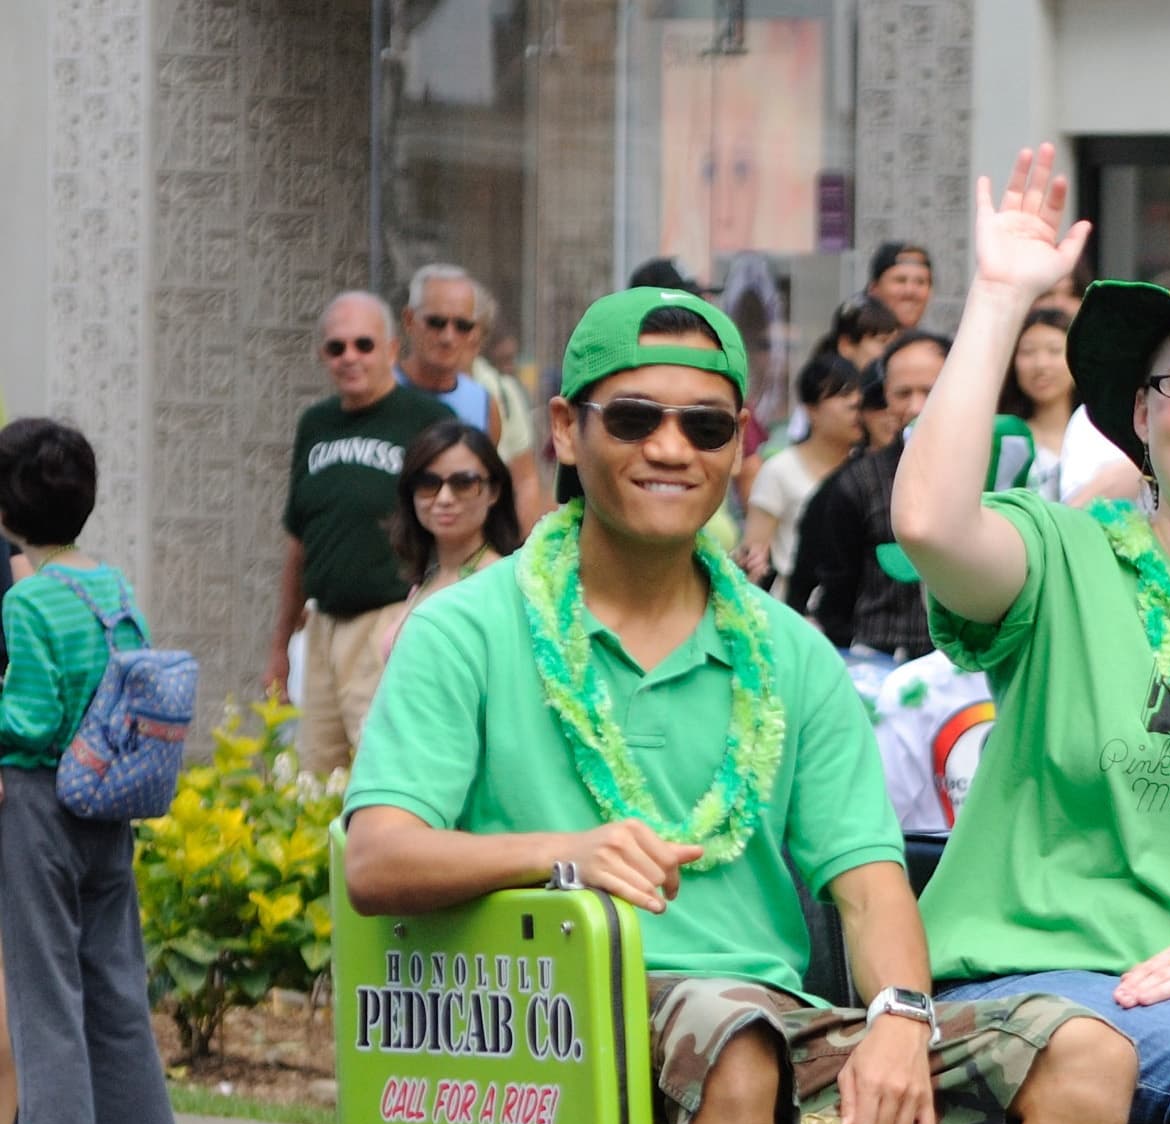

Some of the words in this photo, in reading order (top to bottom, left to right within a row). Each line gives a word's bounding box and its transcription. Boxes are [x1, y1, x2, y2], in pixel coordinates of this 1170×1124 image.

[307, 436, 406, 475] GUINNESS
[387, 953, 551, 991] HONOLULU
[356, 989, 513, 1053] PEDICAB
[526, 996, 582, 1058] CO.
[382, 1079, 425, 1119] CALL
[433, 1083, 476, 1122] FOR
[480, 1086, 496, 1122] A
